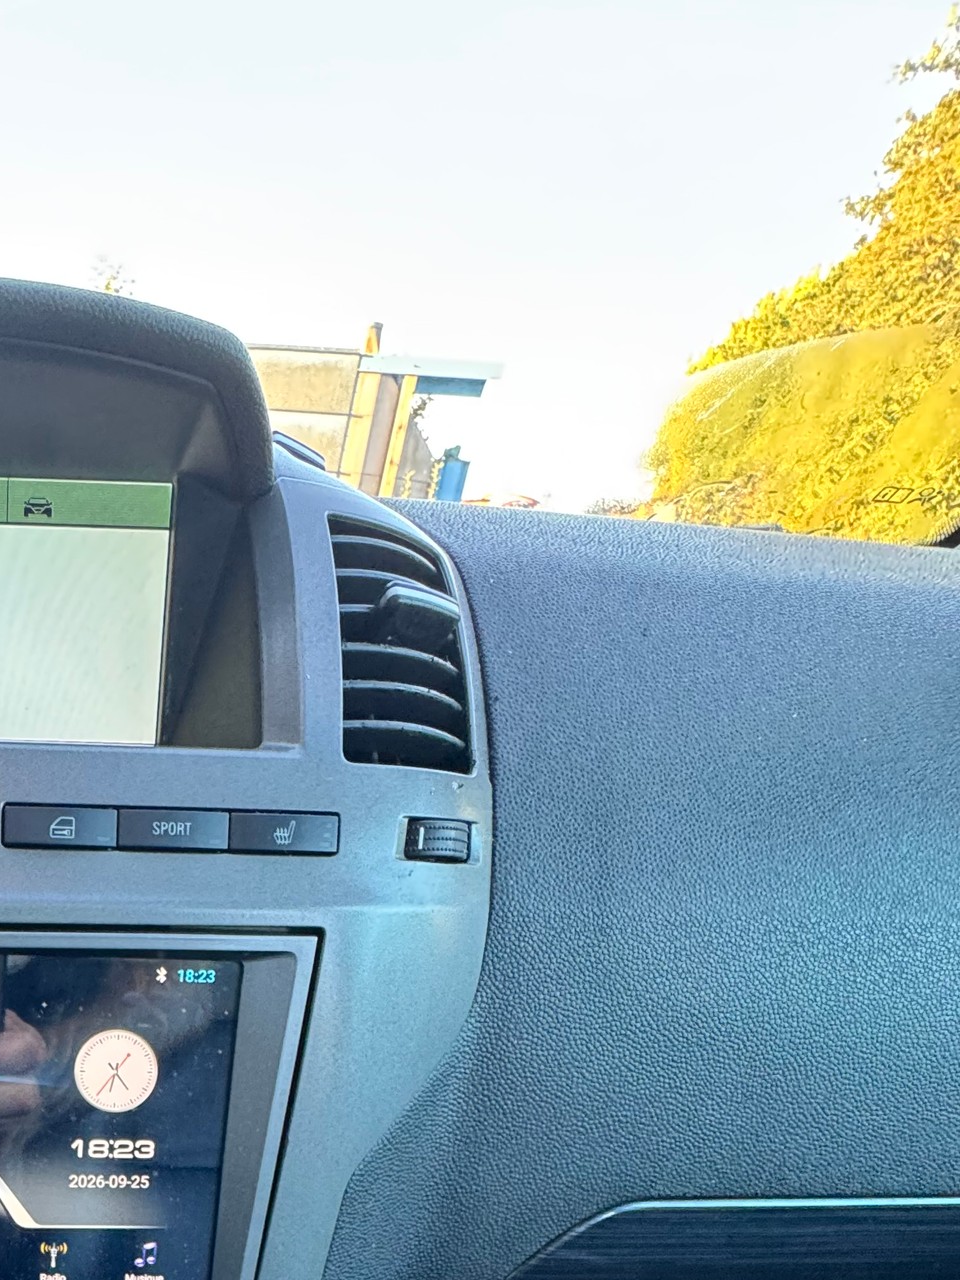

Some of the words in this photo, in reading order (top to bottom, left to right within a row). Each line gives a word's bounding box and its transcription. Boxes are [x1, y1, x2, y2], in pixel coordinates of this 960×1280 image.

[152, 821, 192, 836] SPORT
[177, 969, 216, 984] 18:23
[70, 1138, 156, 1160] 18:23
[68, 1174, 151, 1190] 2026-09-25
